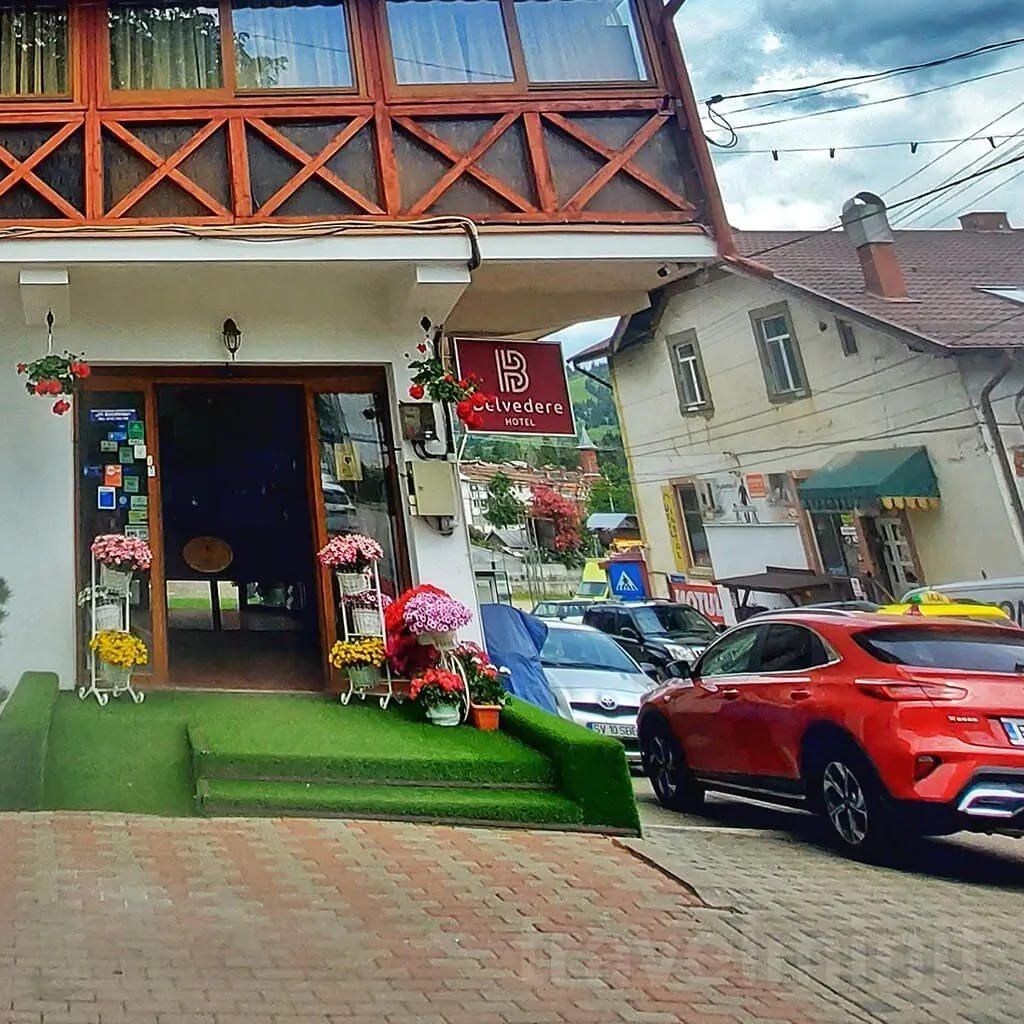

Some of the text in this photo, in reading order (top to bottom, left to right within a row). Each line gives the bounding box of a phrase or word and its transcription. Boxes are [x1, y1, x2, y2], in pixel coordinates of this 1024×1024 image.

[505, 418, 536, 427] HOTEL
[675, 588, 723, 617] MOTUL
[594, 724, 606, 734] SV
[609, 725, 618, 735] 10
